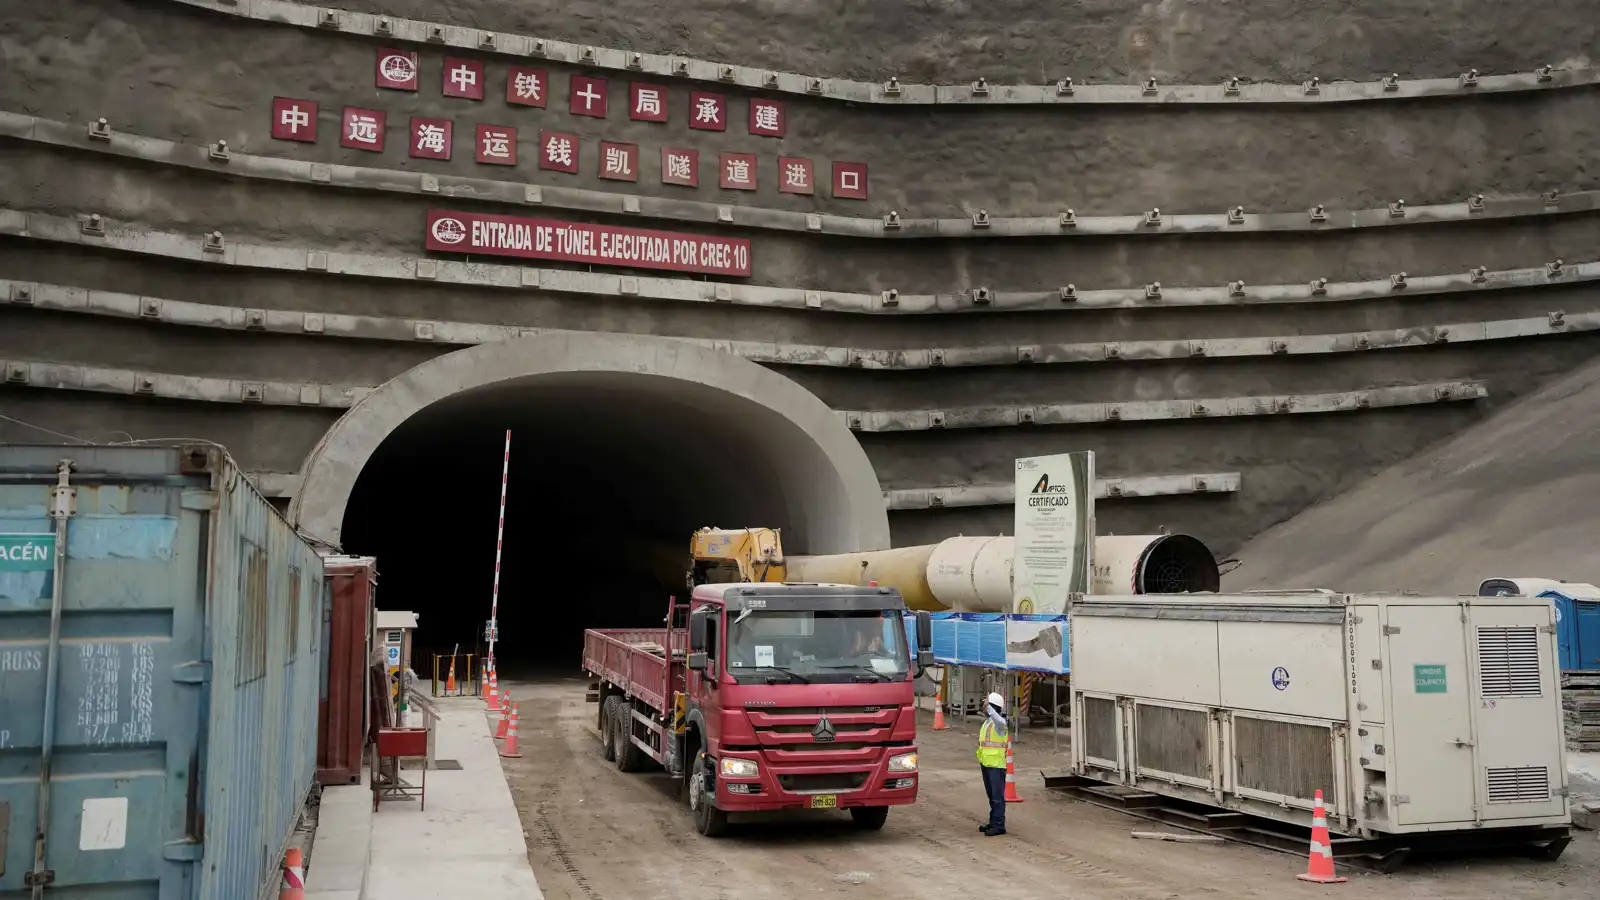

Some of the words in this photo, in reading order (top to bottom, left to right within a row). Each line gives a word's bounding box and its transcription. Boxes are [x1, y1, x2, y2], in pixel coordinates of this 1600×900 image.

[451, 64, 779, 131] 中铁十局承建
[281, 105, 859, 190] 中远海运钱凯隧道进口
[471, 220, 532, 250] ENTRADA
[536, 226, 553, 252] DE
[556, 225, 597, 256] TÚNEL
[600, 232, 670, 263] EJECUTADA
[673, 239, 698, 265] POR
[700, 242, 731, 268] CREC
[733, 245, 747, 269] 10
[1028, 496, 1069, 508] CERTIFICADO
[0, 541, 48, 561] ACÉN
